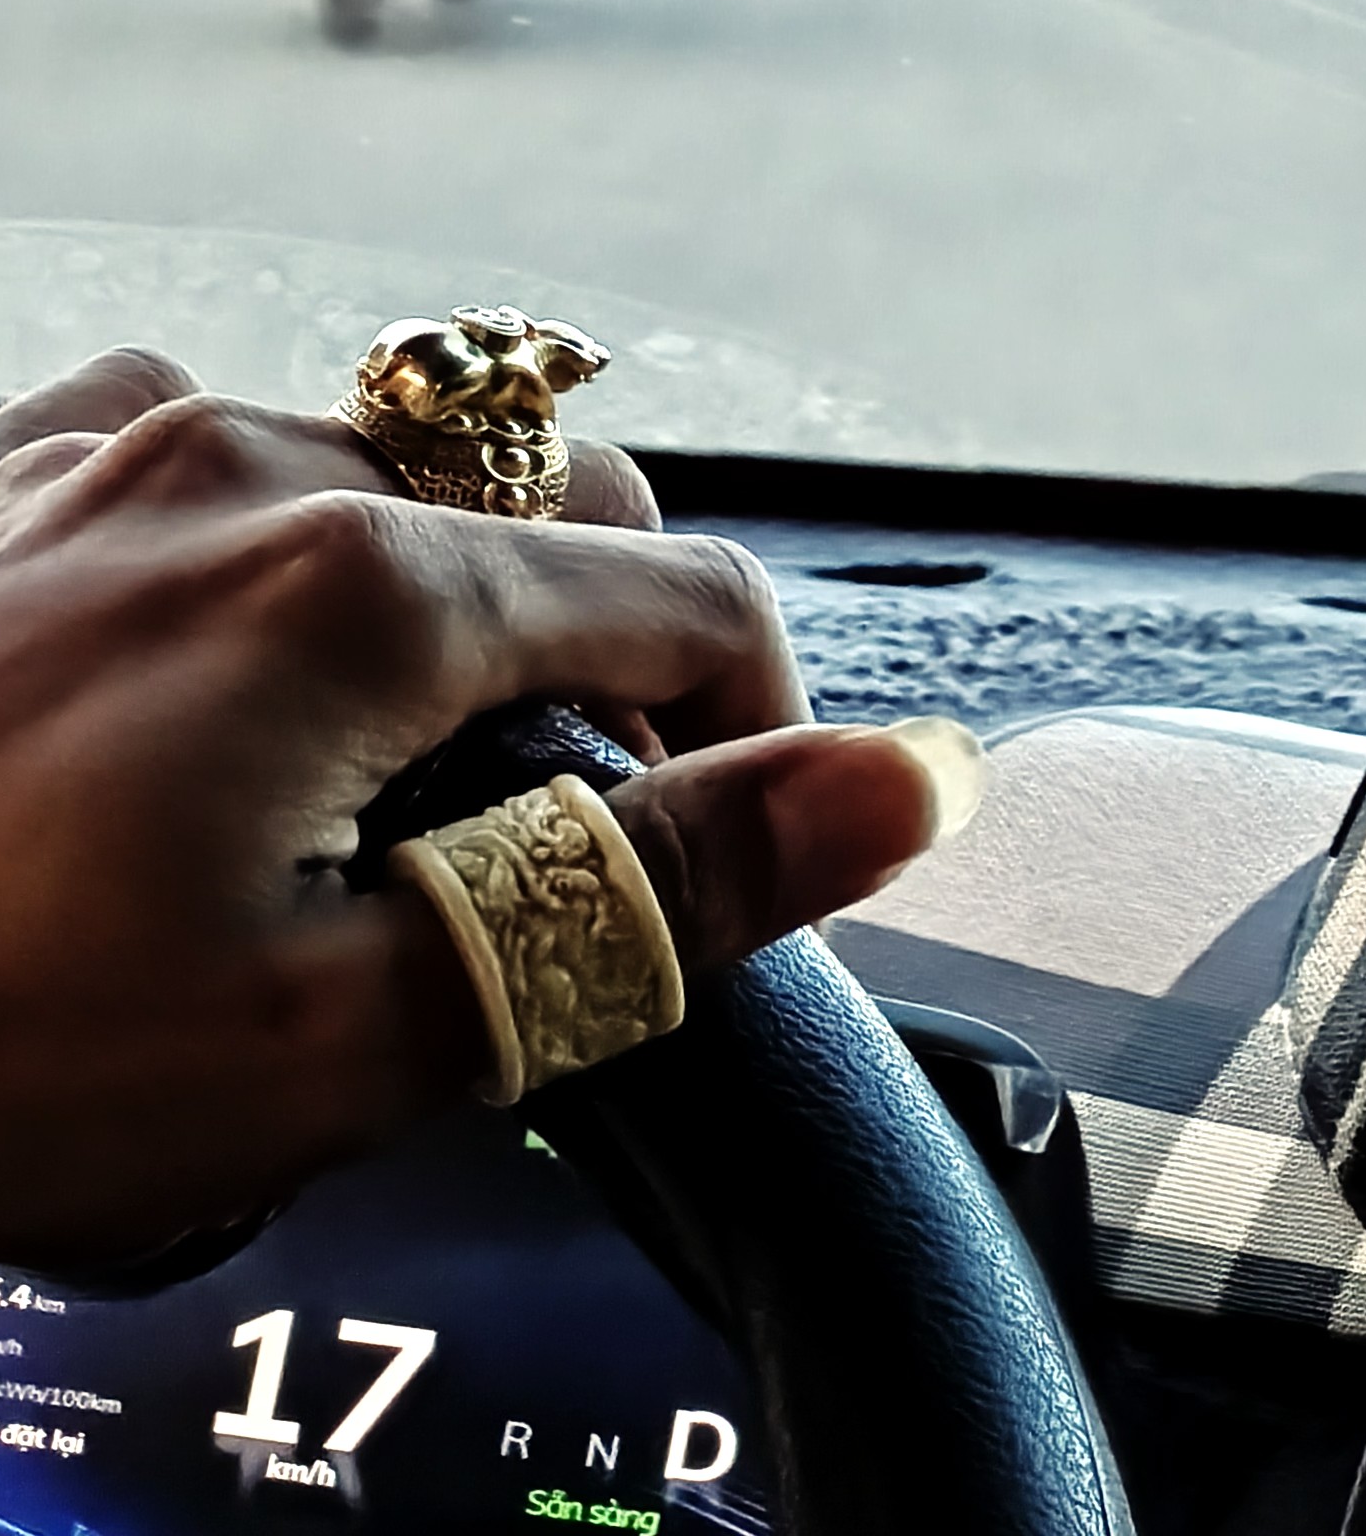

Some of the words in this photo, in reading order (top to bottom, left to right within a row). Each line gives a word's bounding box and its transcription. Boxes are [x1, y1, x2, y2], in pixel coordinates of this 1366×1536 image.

[212, 1308, 438, 1453] 17
[0, 1422, 47, 1453] đặt
[50, 1427, 86, 1458] lại
[500, 1420, 534, 1460] R
[585, 1433, 621, 1472] N
[663, 1408, 739, 1483] D
[264, 1452, 337, 1488] km/h
[588, 1497, 661, 1536] sàng
